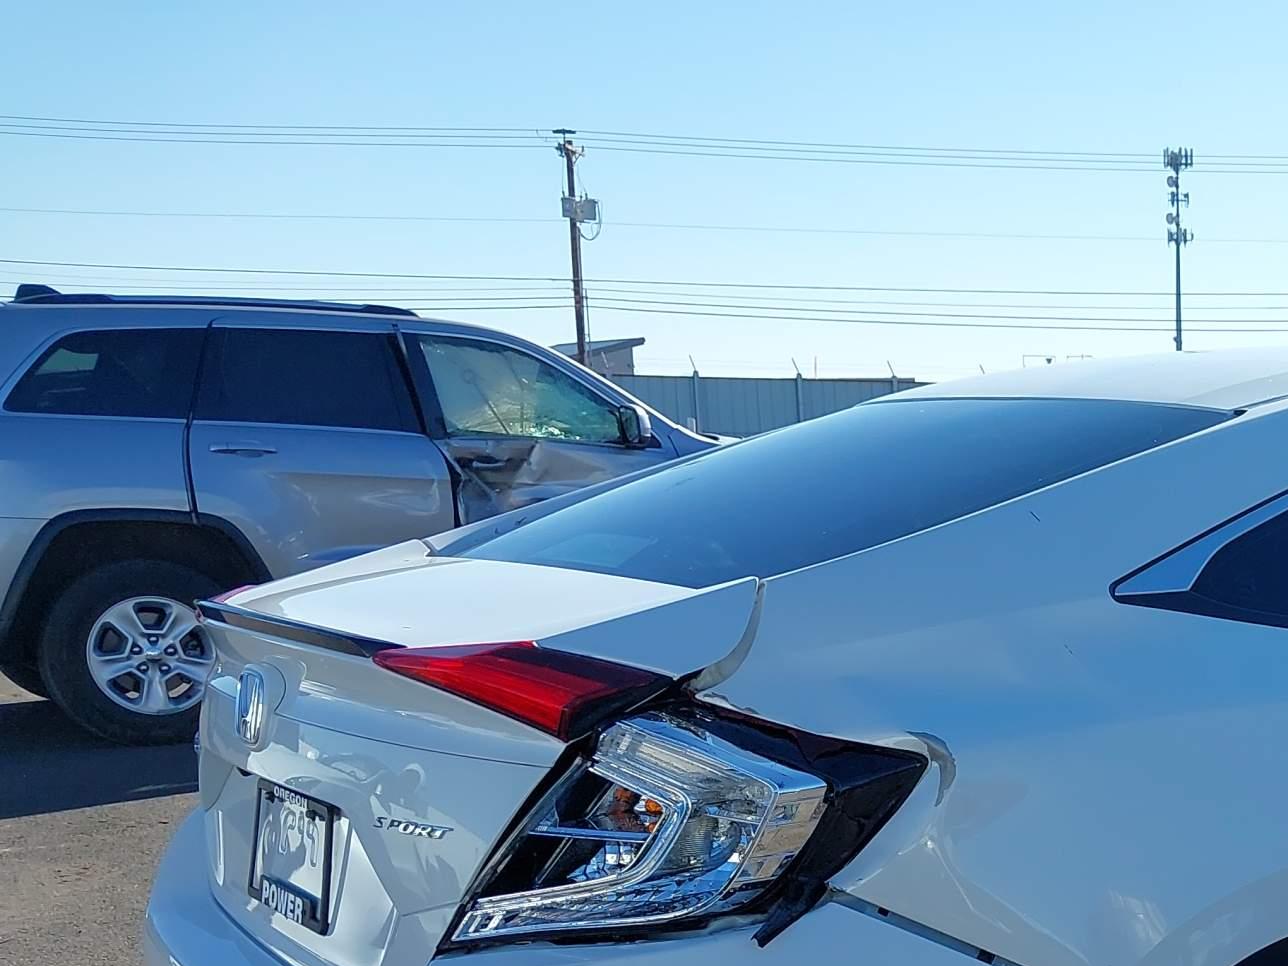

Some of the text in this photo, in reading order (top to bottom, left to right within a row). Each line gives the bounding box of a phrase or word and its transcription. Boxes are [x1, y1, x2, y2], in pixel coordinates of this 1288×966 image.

[273, 785, 308, 809] OREGON
[373, 816, 454, 840] SPORT
[262, 879, 303, 924] POWER
